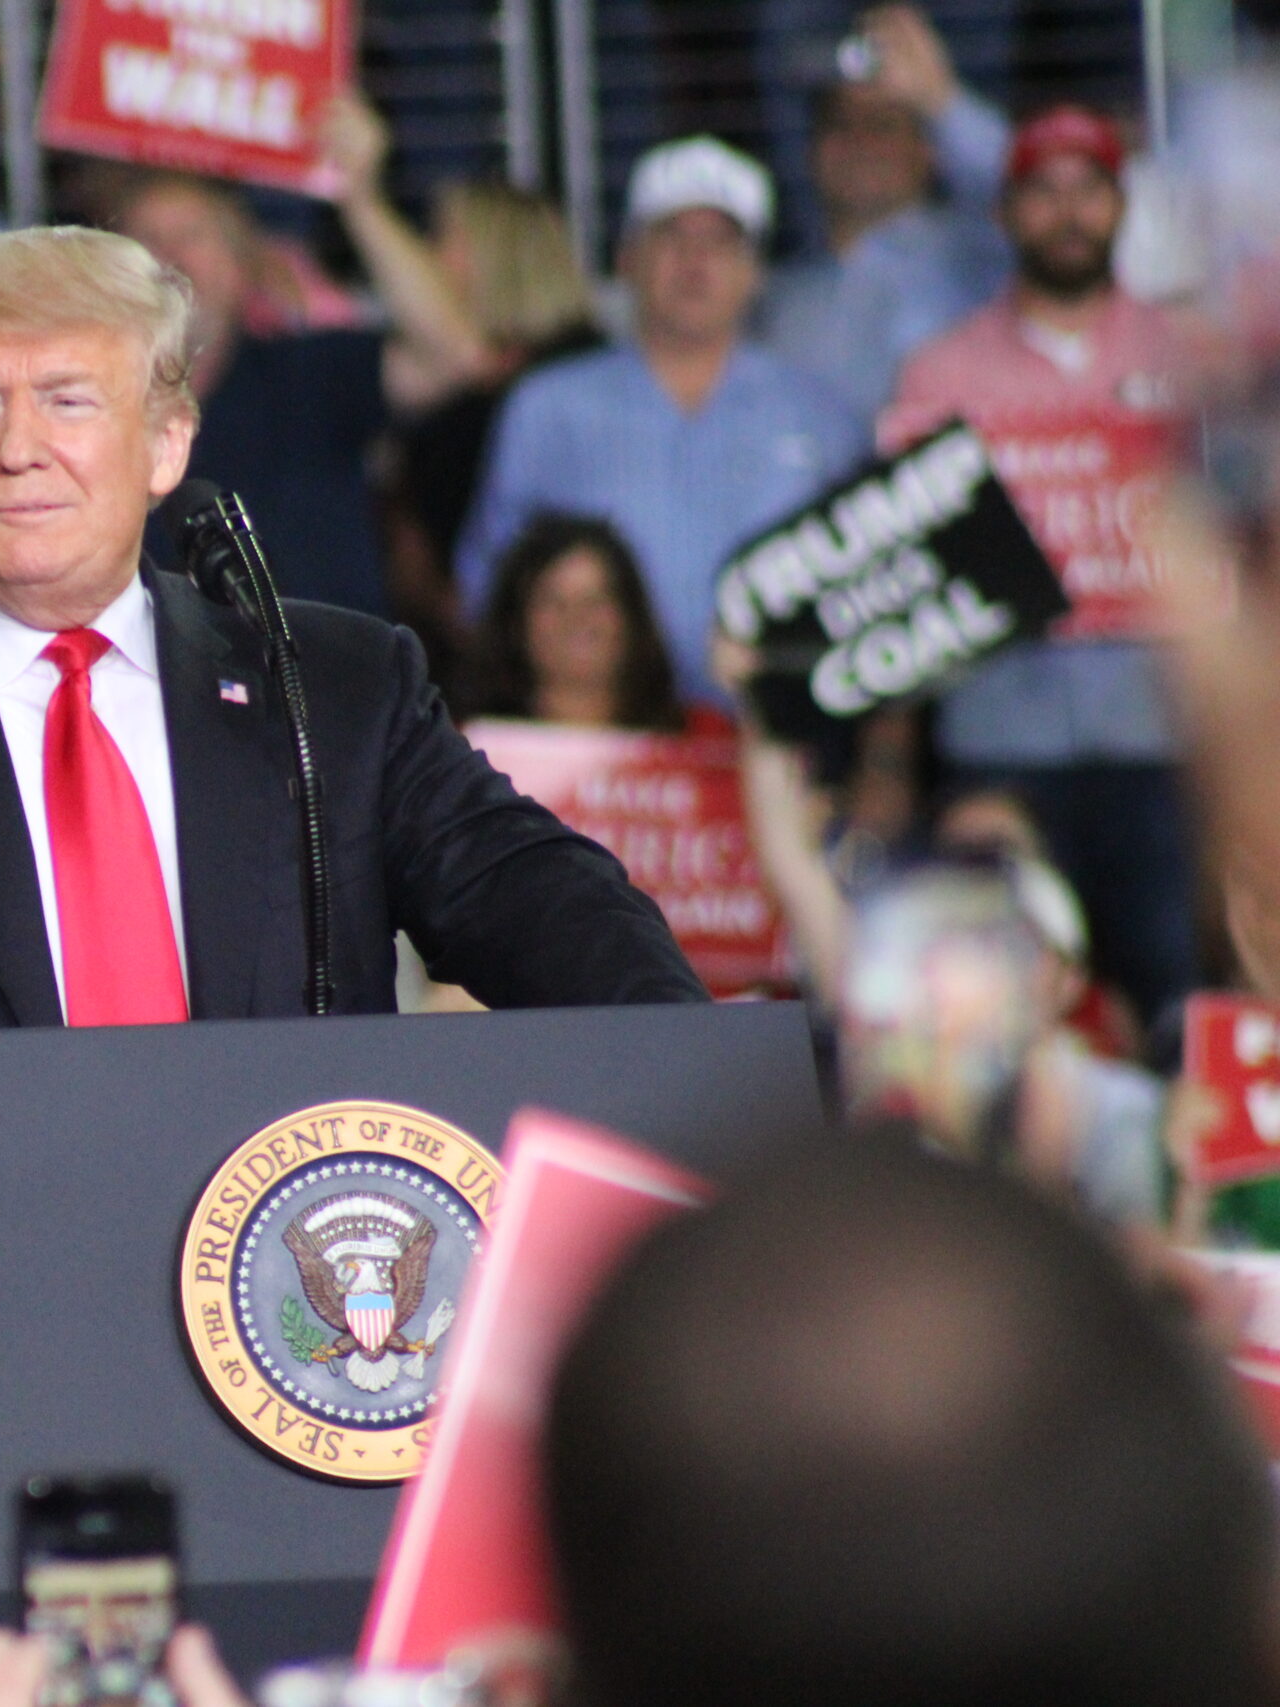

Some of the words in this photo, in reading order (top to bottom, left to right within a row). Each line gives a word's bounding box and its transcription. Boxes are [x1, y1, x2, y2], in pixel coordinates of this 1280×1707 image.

[102, 43, 298, 147] WALL
[717, 428, 985, 643] TRUMP
[810, 576, 1012, 716] COAL
[359, 1120, 391, 1143] OF
[399, 1127, 445, 1161] THE
[195, 1117, 346, 1285] PRESIDENT
[201, 1301, 229, 1352] THE
[219, 1359, 248, 1388] OF
[252, 1386, 344, 1462] SEAL
